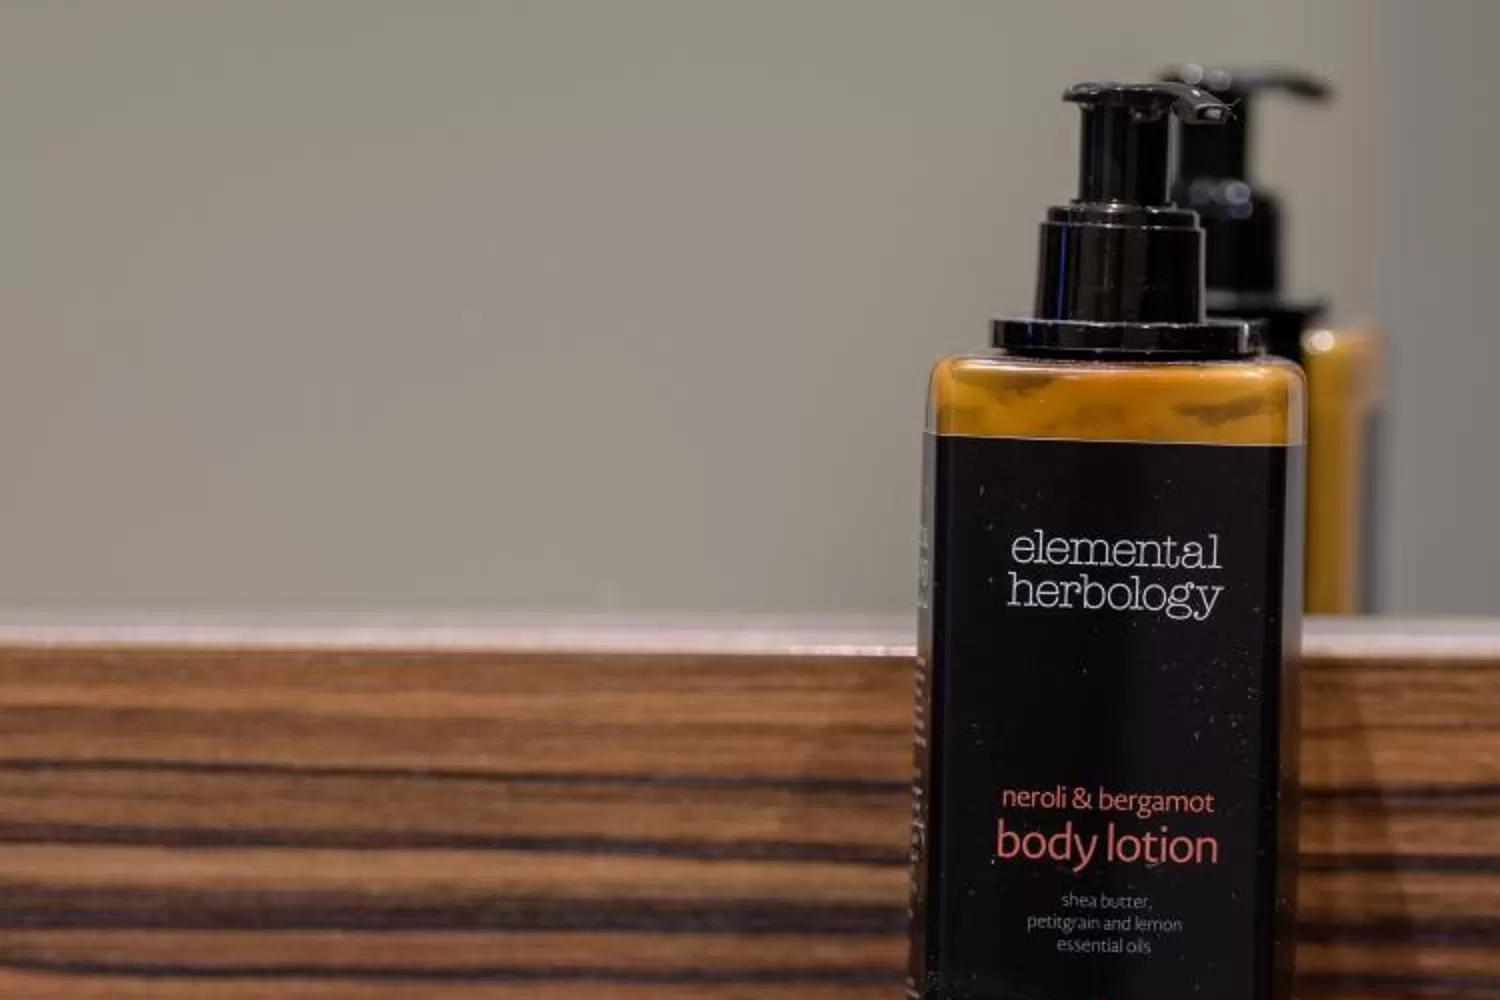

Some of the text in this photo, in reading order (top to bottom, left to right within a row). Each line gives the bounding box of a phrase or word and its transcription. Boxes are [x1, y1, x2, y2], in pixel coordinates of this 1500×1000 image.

[1010, 529, 1224, 570] elemental
[1006, 571, 1224, 621] herbology
[1002, 784, 1216, 819] neroli & bergamot
[997, 818, 1218, 873] body lotion
[1060, 890, 1153, 912] shea butter,
[1026, 914, 1183, 936] petitgrain and lemon
[1056, 937, 1152, 955] essential oils
